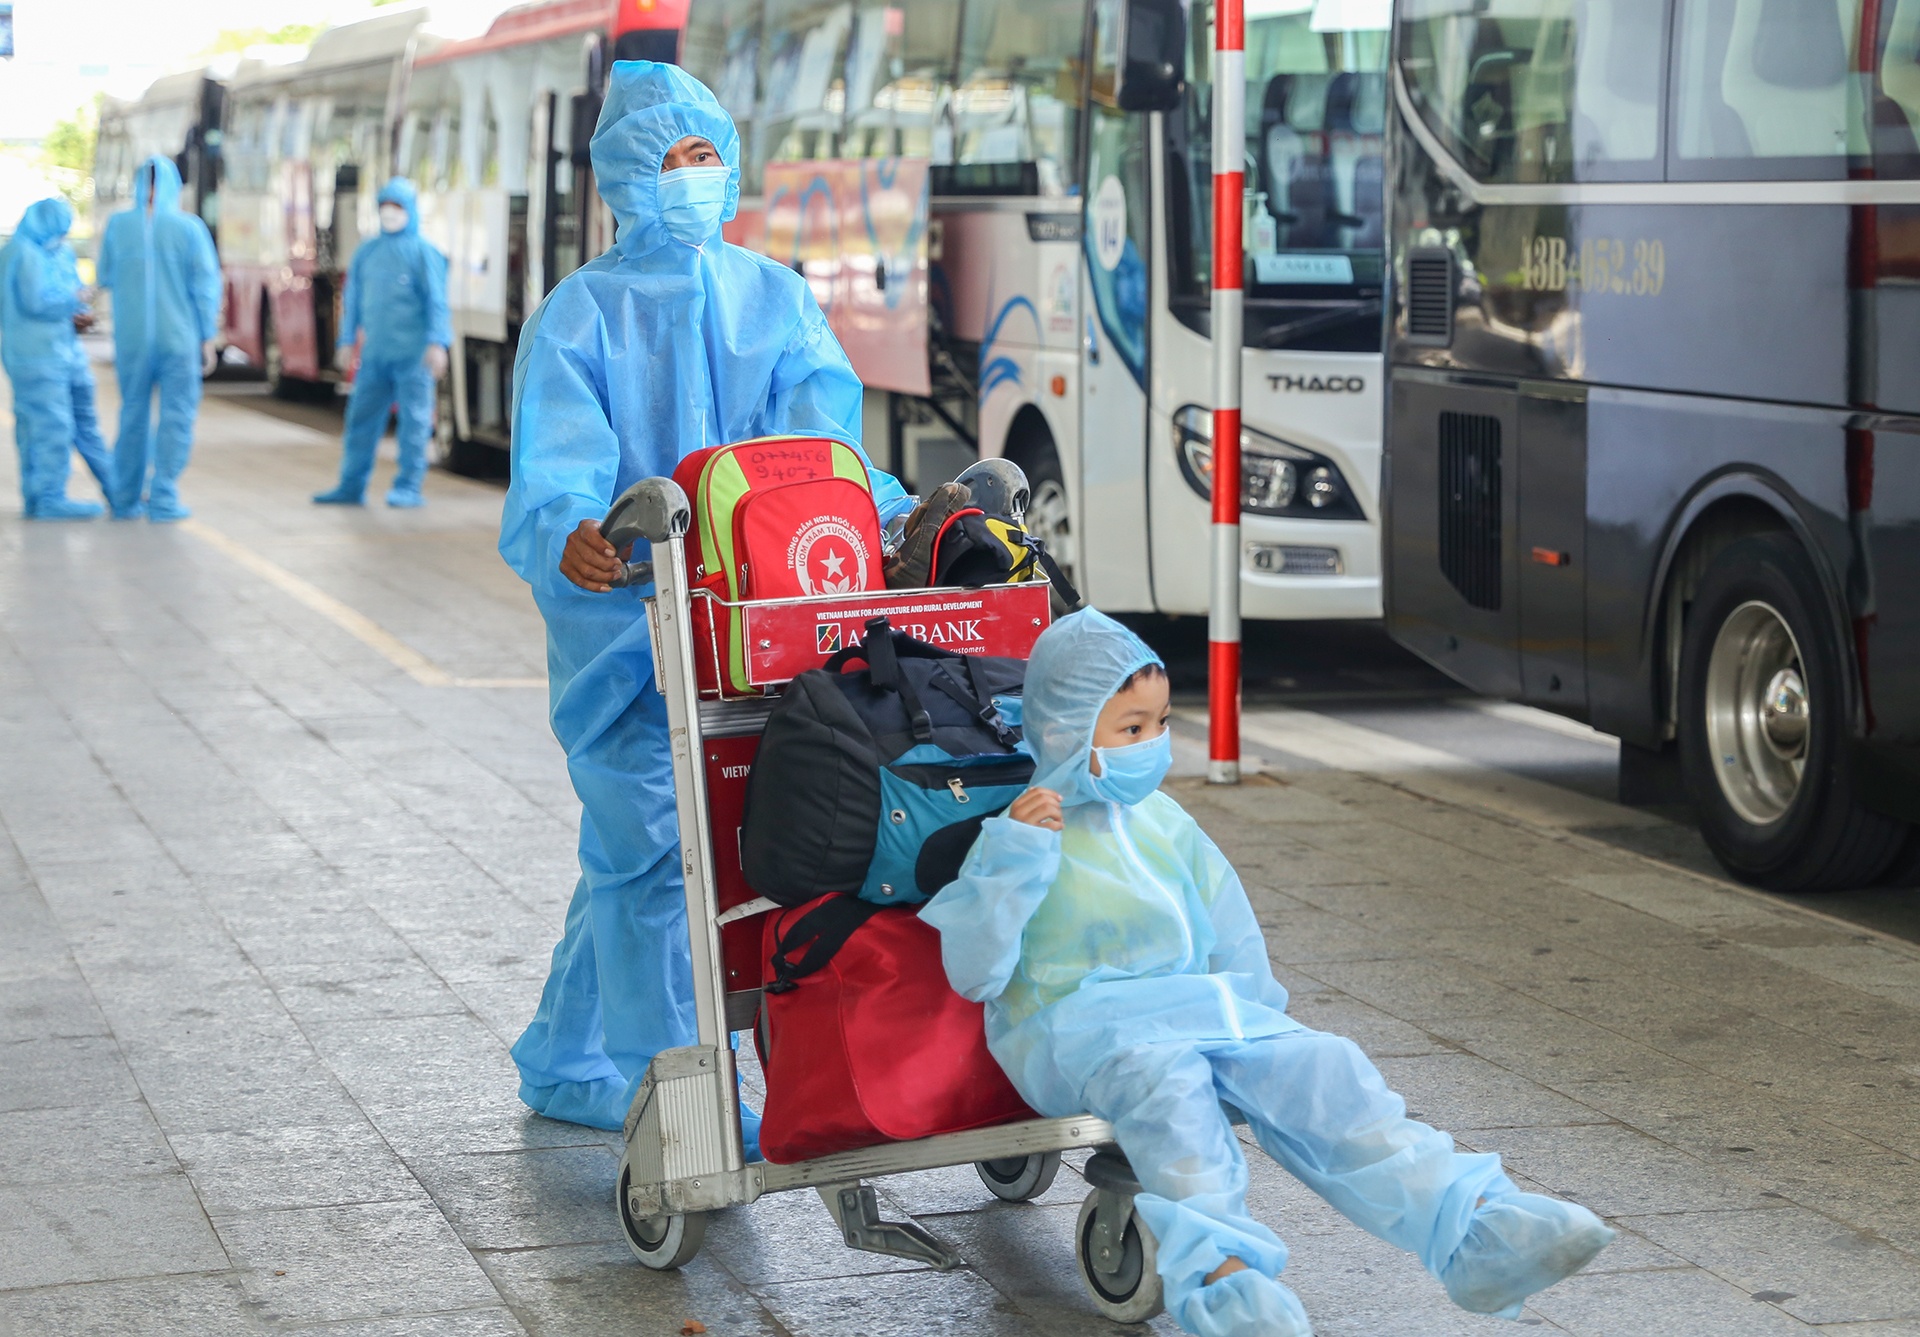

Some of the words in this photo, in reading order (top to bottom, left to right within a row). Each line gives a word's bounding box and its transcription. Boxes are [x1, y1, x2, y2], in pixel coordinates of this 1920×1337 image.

[1267, 374, 1365, 393] THACO
[813, 515, 831, 524] NON
[849, 525, 863, 540] SAO
[853, 543, 863, 559] LAI
[816, 610, 843, 620] VIETNAM
[843, 608, 860, 618] BANK
[860, 608, 872, 617] FOR
[872, 605, 910, 616] AGRICULTURE
[910, 604, 924, 613] AND
[923, 603, 943, 612] RURAL
[942, 600, 983, 611] DEVELOPMENT
[847, 619, 984, 648] ABANK
